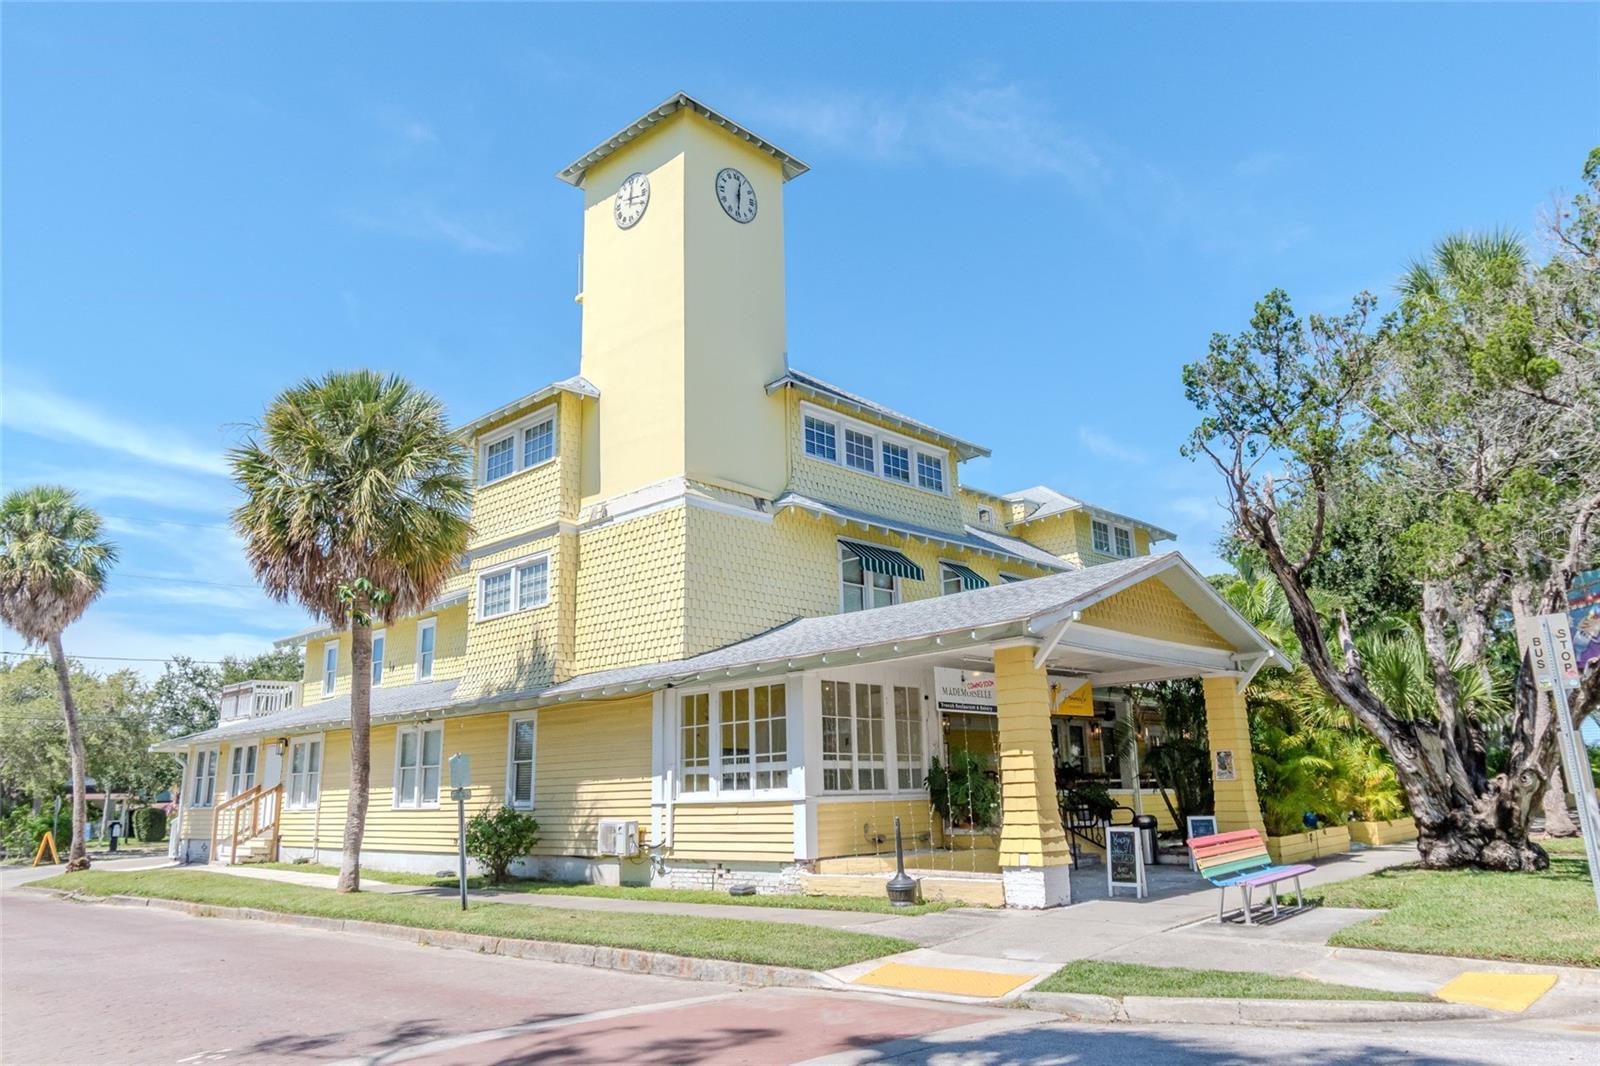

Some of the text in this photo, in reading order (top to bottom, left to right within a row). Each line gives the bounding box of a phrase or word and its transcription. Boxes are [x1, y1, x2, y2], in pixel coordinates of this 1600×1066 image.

[1532, 637, 1546, 669] BUS
[1556, 628, 1572, 672] STOP
[942, 686, 993, 699] MADEMOISELLE
